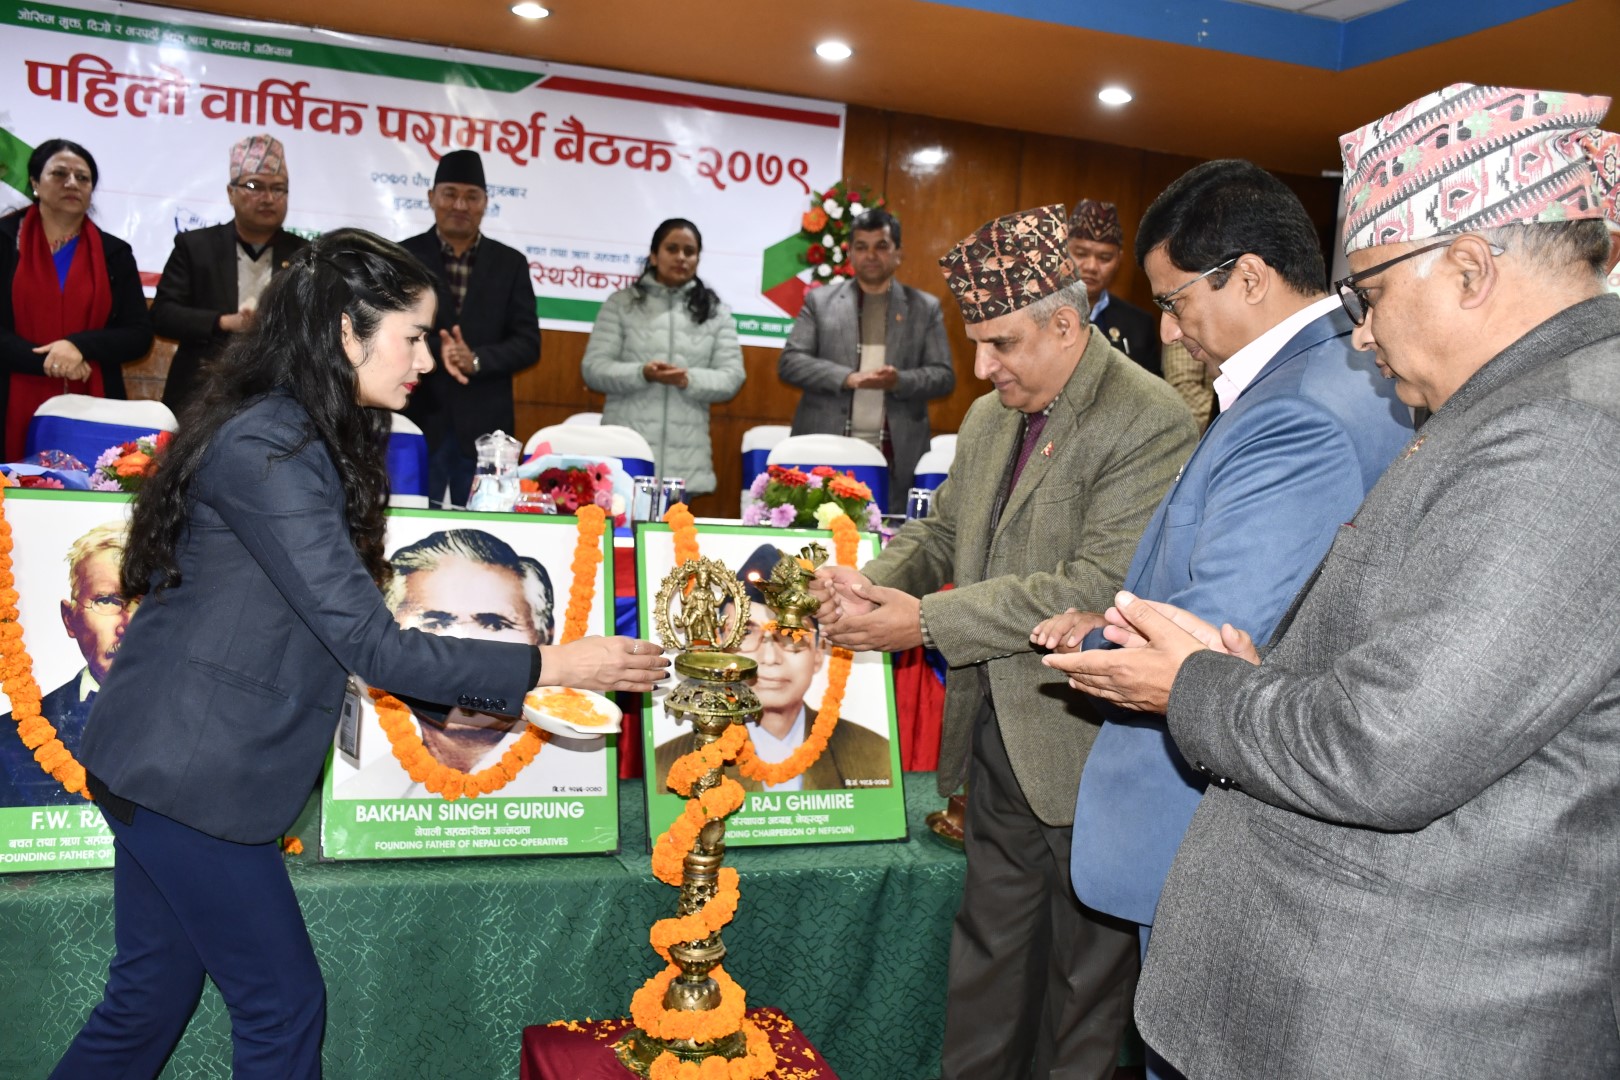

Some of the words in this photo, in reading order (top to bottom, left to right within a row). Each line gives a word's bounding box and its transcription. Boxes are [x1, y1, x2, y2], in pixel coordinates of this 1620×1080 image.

[25, 53, 191, 118] पहिलो
[200, 78, 368, 136] वार्षिक
[376, 106, 546, 166] परामर्श
[751, 796, 781, 812] RAJ
[786, 793, 854, 811] GHIMIRE
[356, 804, 432, 822] BAKHAN
[438, 803, 497, 820] SINGH
[503, 801, 585, 819] GURUNG
[752, 827, 804, 837] CHAIRPERSON
[806, 827, 817, 835] OF
[375, 840, 423, 850] FOUNDING
[425, 839, 455, 849] FATHER
[458, 839, 470, 848] OF
[472, 838, 501, 848] NEPALI
[503, 837, 568, 847] CO-OPERATIVES
[0, 852, 56, 863] FOUNDING
[59, 850, 95, 860] FATHER
[97, 849, 112, 858] OF
